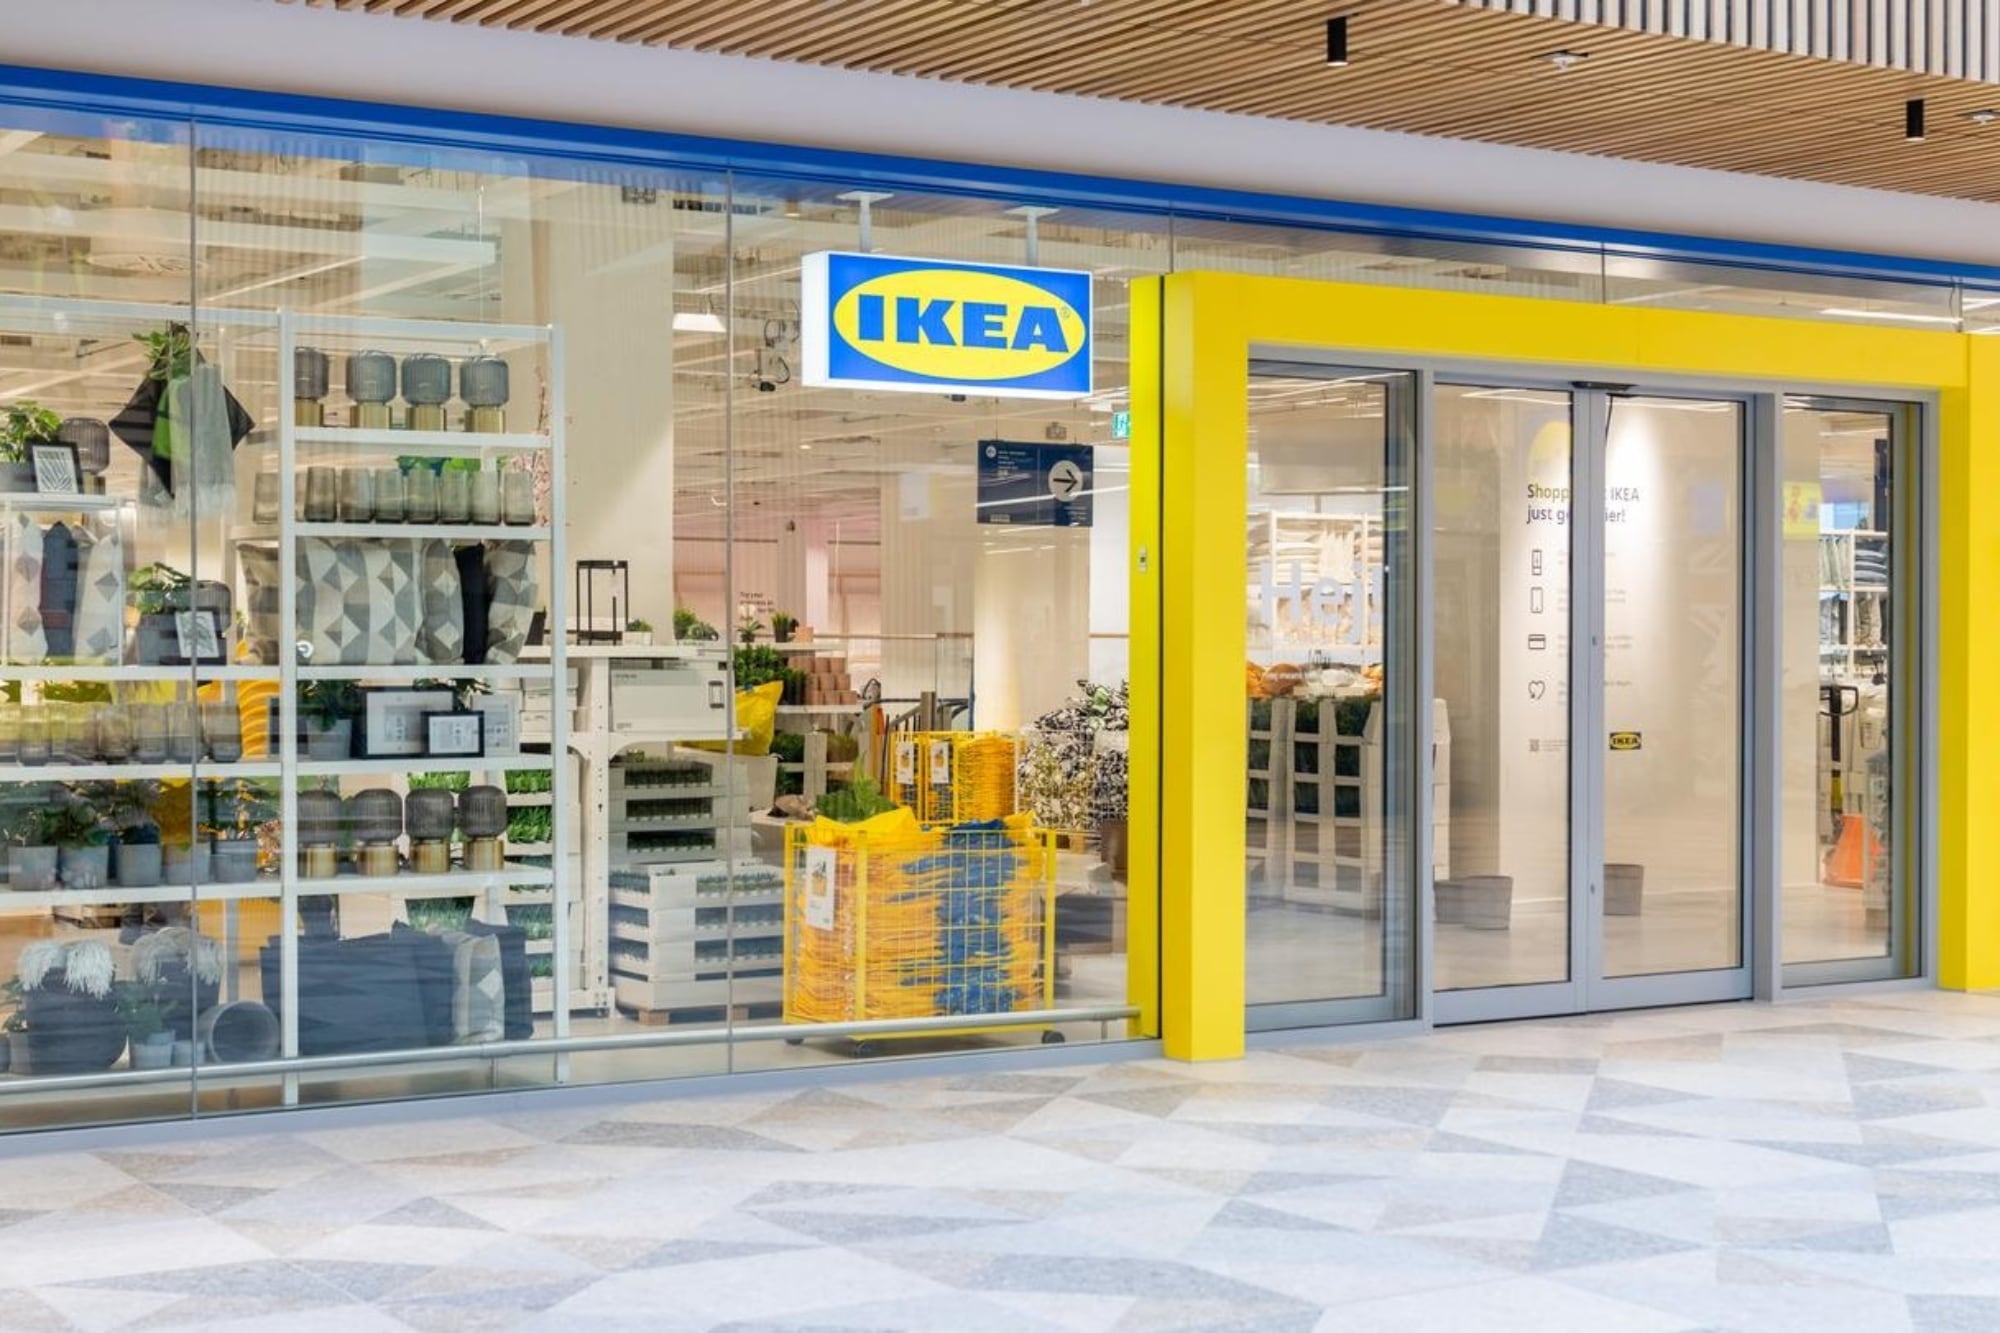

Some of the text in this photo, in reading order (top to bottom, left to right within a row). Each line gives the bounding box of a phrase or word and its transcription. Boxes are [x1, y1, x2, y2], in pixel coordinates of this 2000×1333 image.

[858, 294, 1069, 353] IKEA
[1527, 483, 1570, 503] Shopp
[1610, 486, 1641, 502] IKEA
[1526, 504, 1553, 525] just
